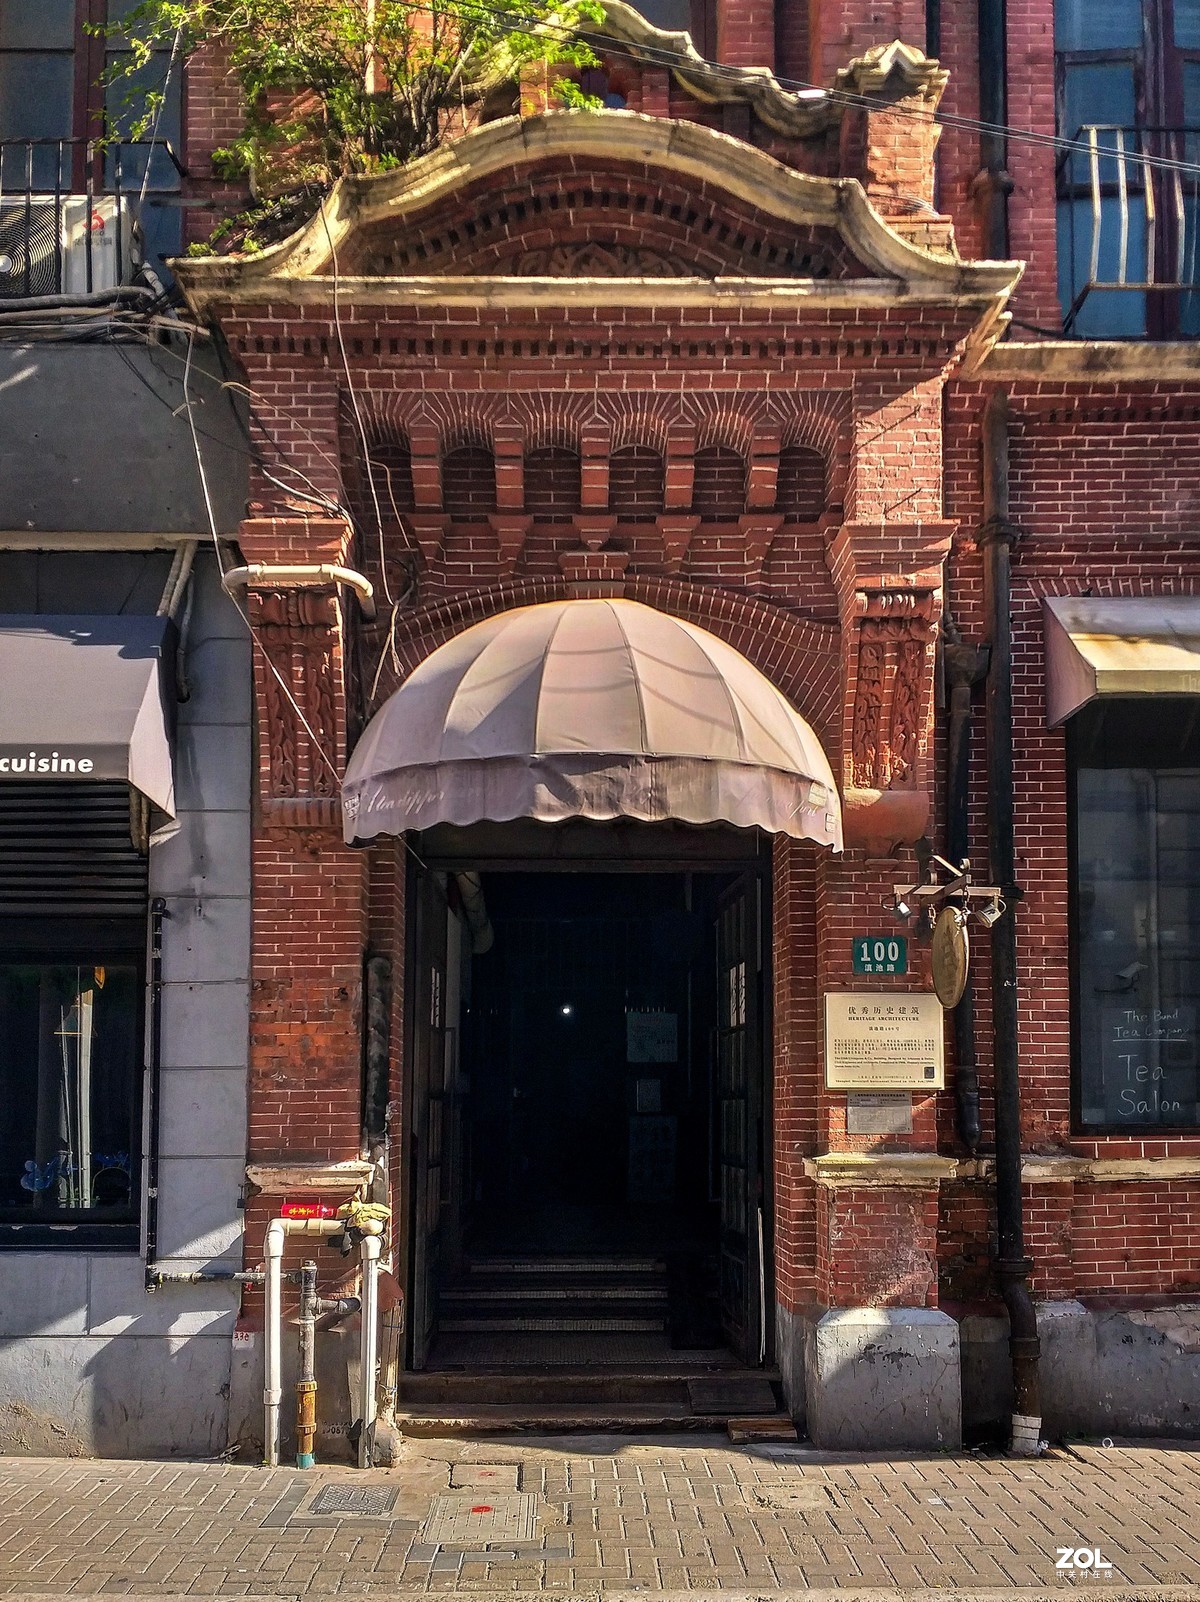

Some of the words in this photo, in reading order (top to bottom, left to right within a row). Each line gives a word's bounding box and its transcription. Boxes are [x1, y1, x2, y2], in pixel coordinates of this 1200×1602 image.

[0, 751, 94, 773] cuisine
[860, 941, 899, 962] 100
[848, 1006, 920, 1015] 优秀历史建筑
[1123, 1010, 1148, 1023] The
[1153, 1009, 1179, 1022] Bund
[1113, 1026, 1140, 1038] Tea
[1118, 1054, 1167, 1082] Tea
[1117, 1089, 1182, 1116] Salon
